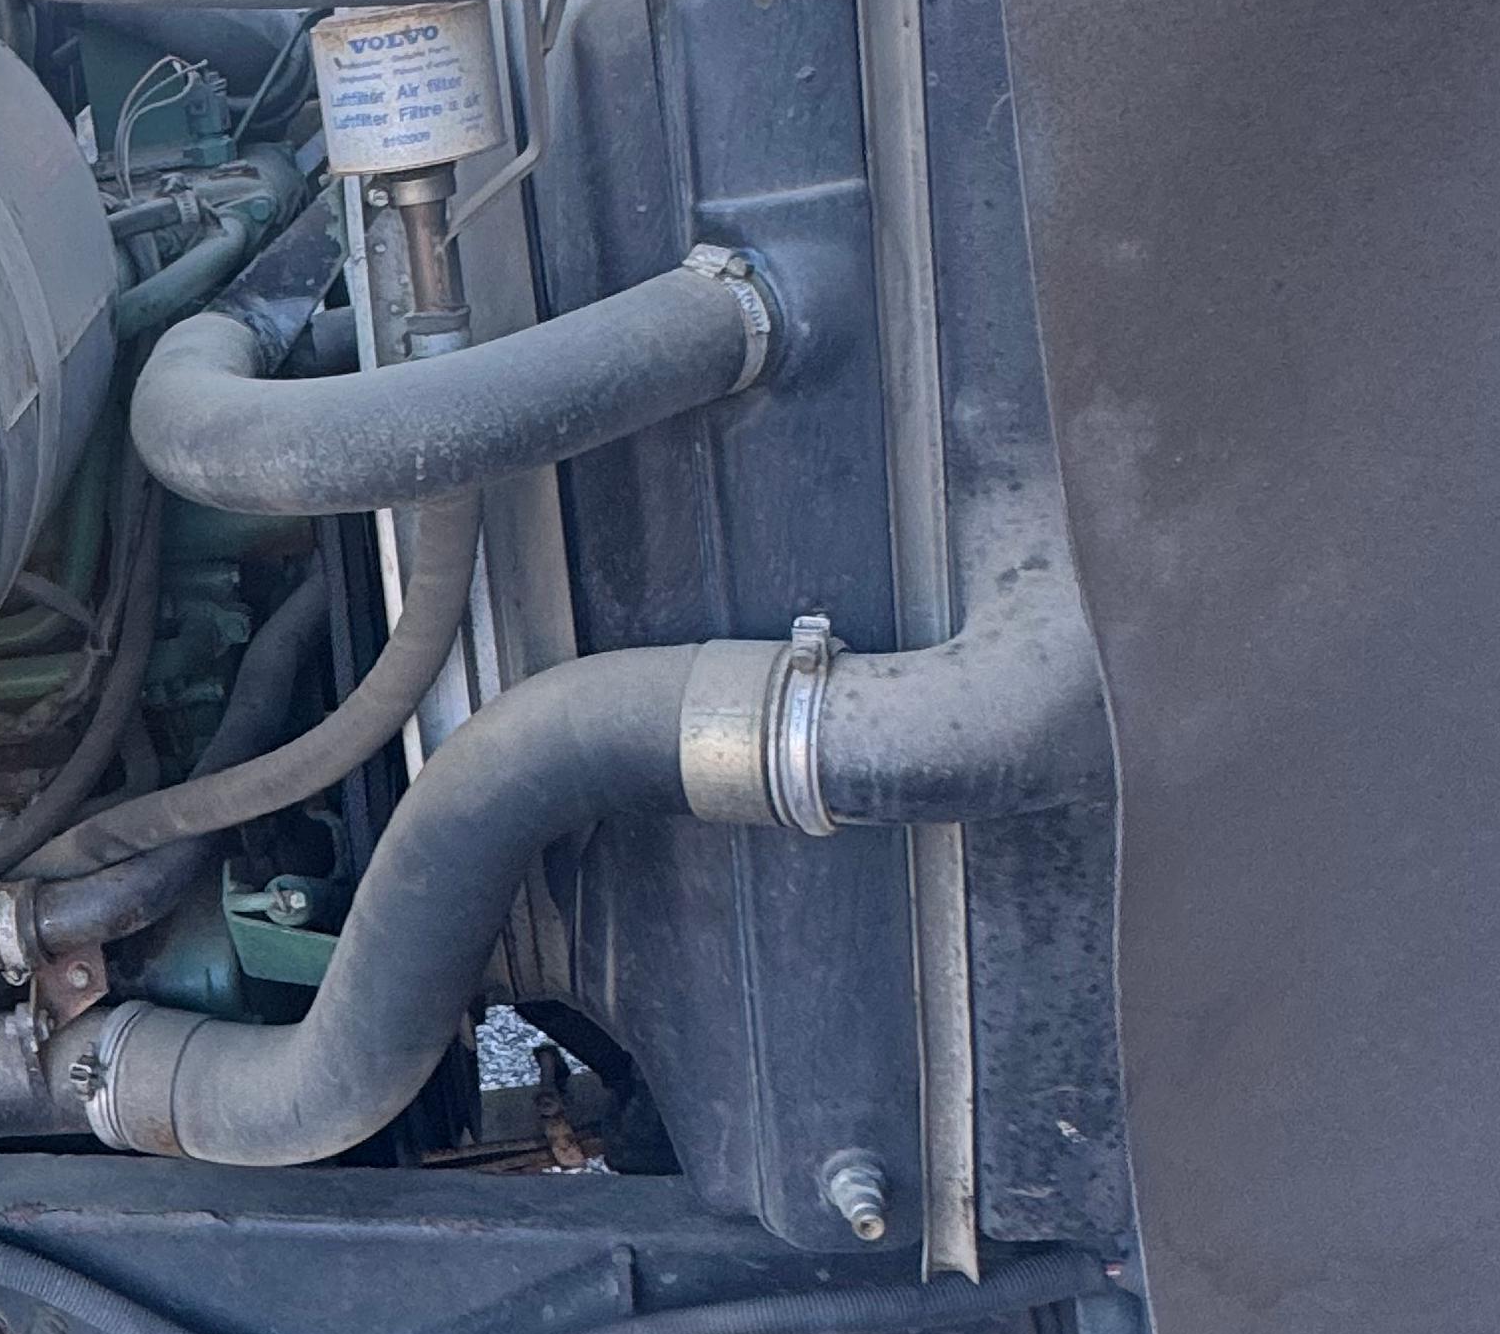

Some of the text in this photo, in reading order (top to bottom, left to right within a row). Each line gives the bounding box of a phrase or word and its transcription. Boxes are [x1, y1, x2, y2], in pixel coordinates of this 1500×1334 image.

[348, 25, 438, 54] VOLVO
[398, 83, 420, 100] Air
[400, 104, 442, 123] Filtre
